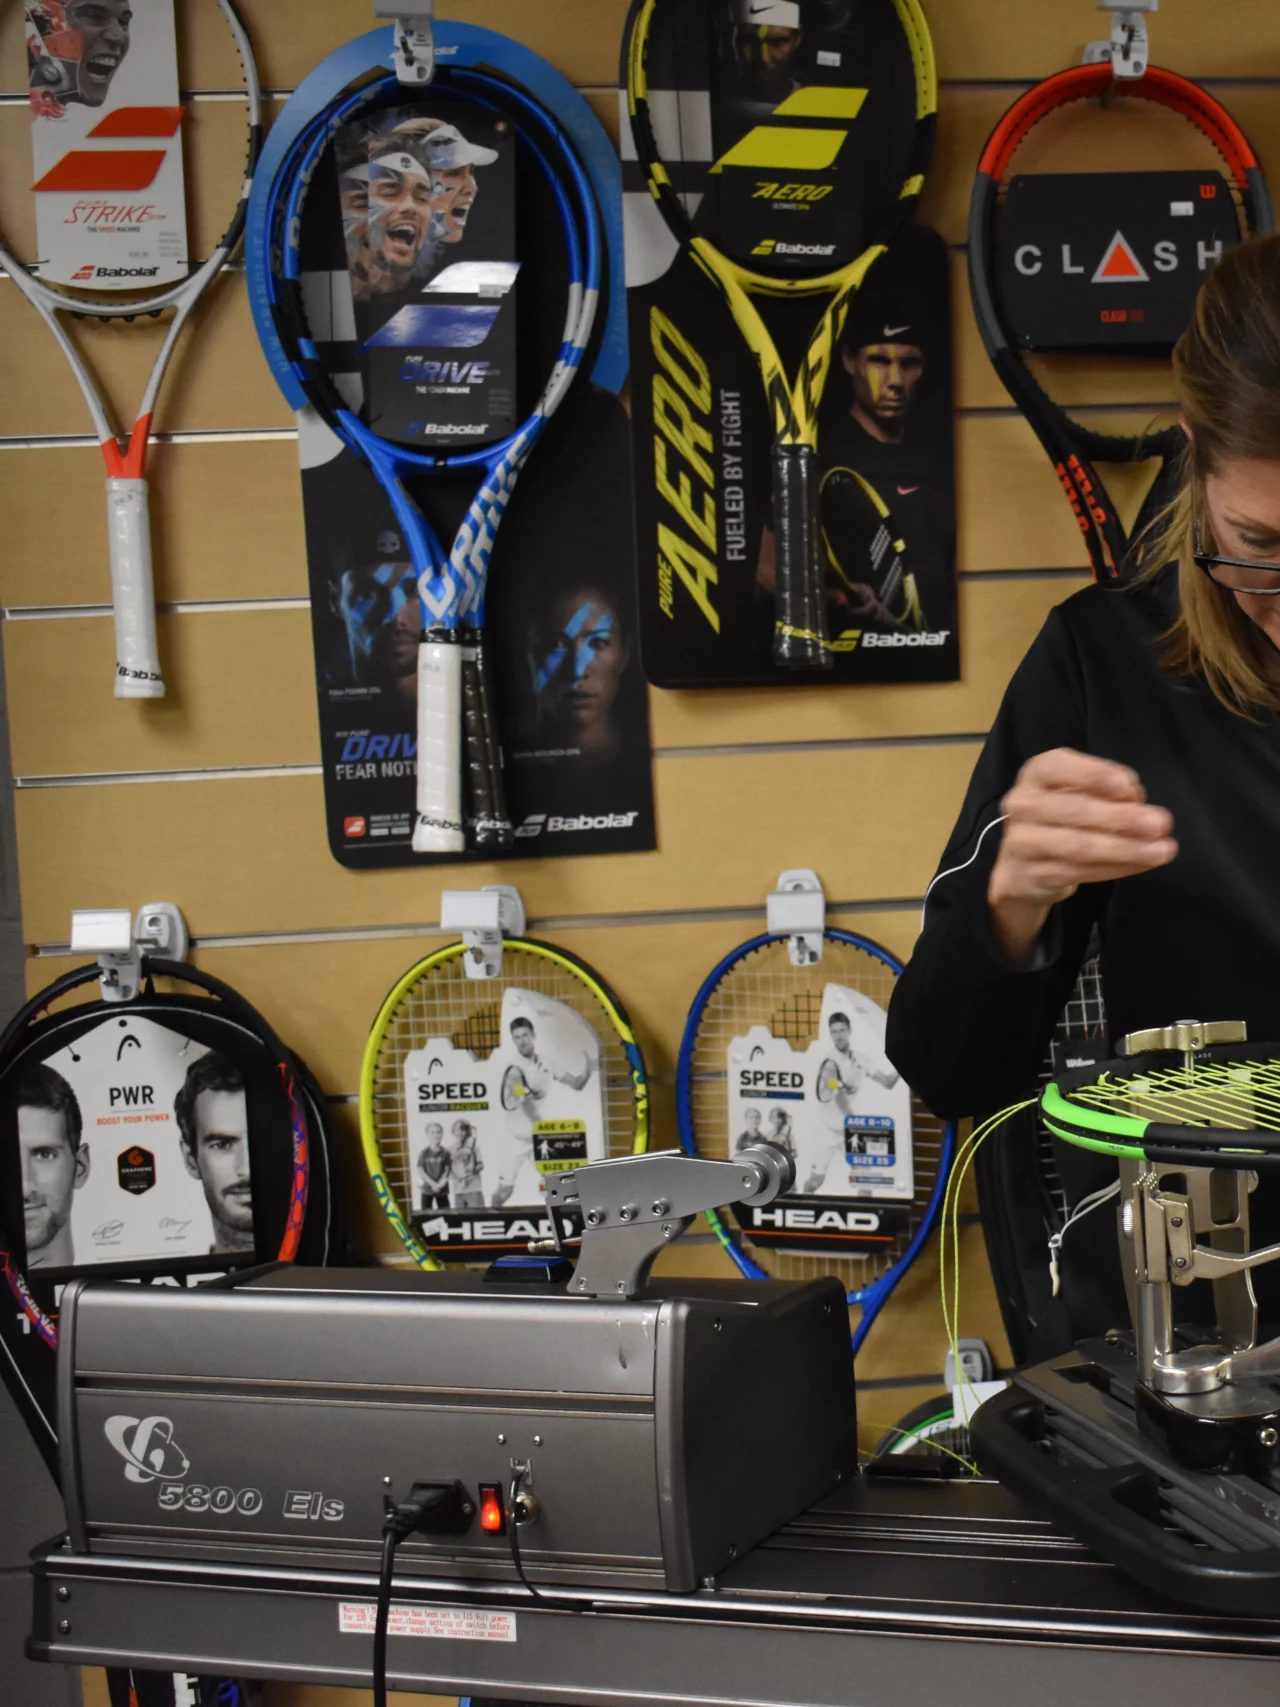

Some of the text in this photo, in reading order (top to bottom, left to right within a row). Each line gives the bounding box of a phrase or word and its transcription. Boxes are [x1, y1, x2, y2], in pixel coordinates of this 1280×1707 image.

[63, 205, 157, 224] STRIKE
[398, 361, 490, 384] DRIVE
[650, 305, 720, 634] PURE AERO
[719, 388, 748, 561] FUELED BY FIGHT
[336, 764, 378, 780] FEAR
[740, 1070, 804, 1088] SPEED
[109, 1085, 154, 1106] PWR
[418, 1082, 487, 1101] SPEED
[96, 1113, 170, 1126] BOOST YOUR POWER
[537, 1122, 558, 1131] AGE
[847, 1118, 866, 1126] AGE
[542, 1162, 564, 1172] SIZE
[852, 1156, 874, 1164] SIZE
[121, 1166, 152, 1174] GRAPHENE
[372, 1173, 417, 1265] HEAD
[753, 1208, 880, 1232] HEAD
[158, 1482, 263, 1516] 5800
